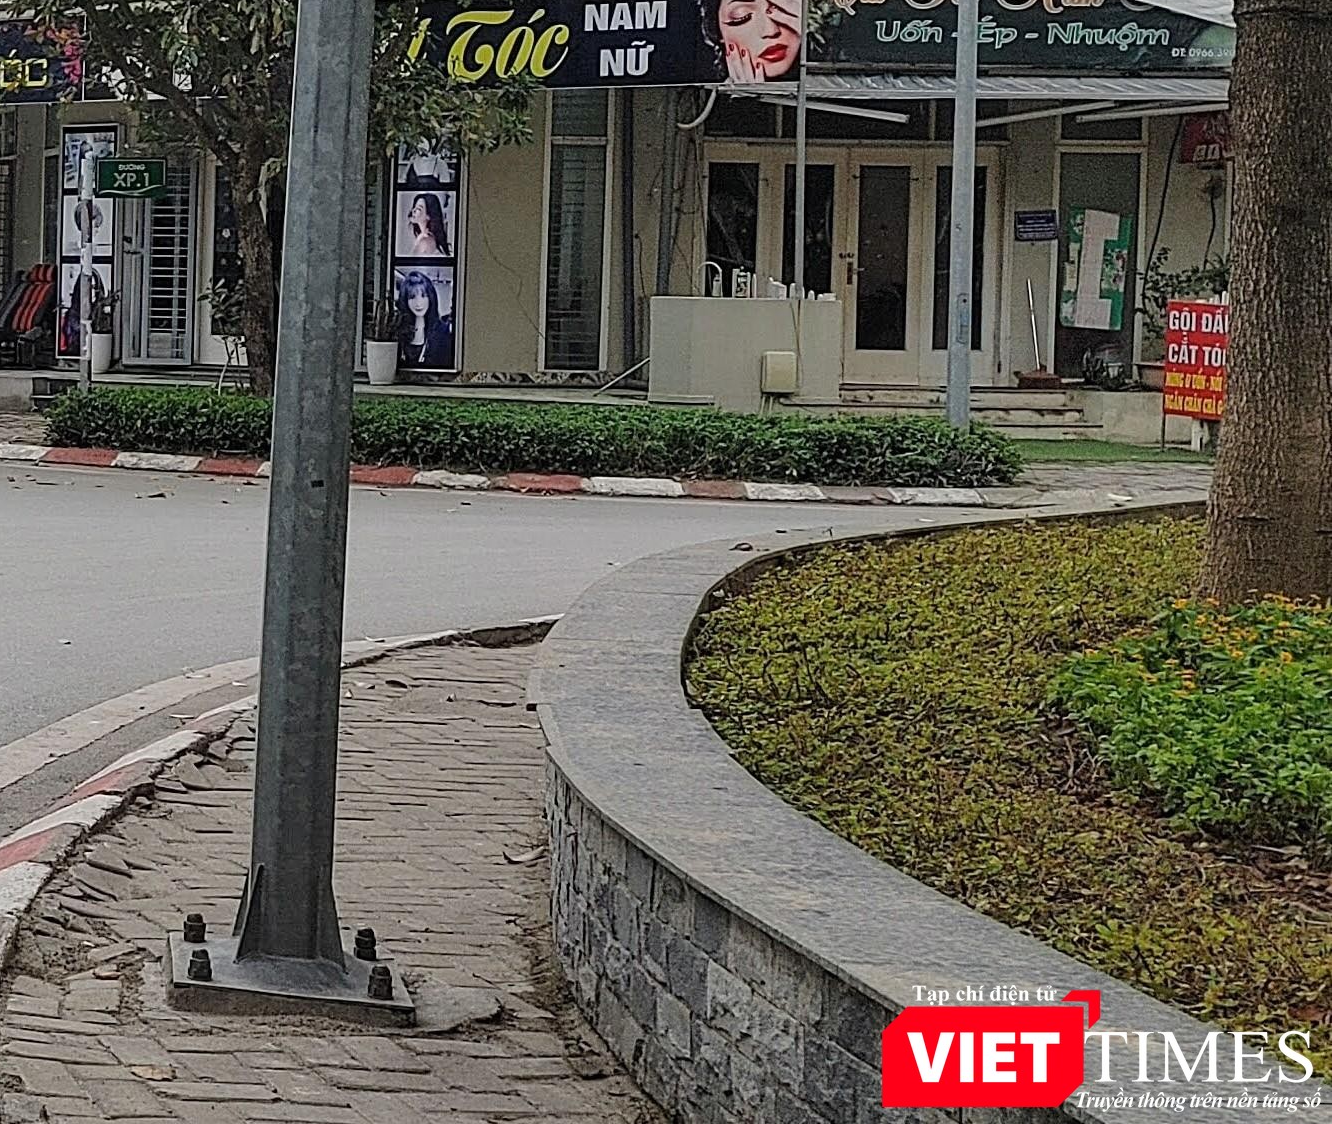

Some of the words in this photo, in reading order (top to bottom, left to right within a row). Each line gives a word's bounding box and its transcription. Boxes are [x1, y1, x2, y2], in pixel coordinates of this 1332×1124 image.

[584, 0, 668, 32] NAM
[445, 8, 570, 83] Tóc
[875, 19, 943, 43] Uốn
[1047, 22, 1170, 51] Nhuộm
[599, 40, 655, 77] NỮ
[113, 172, 150, 188] XP.1
[1168, 307, 1197, 335] GỘI
